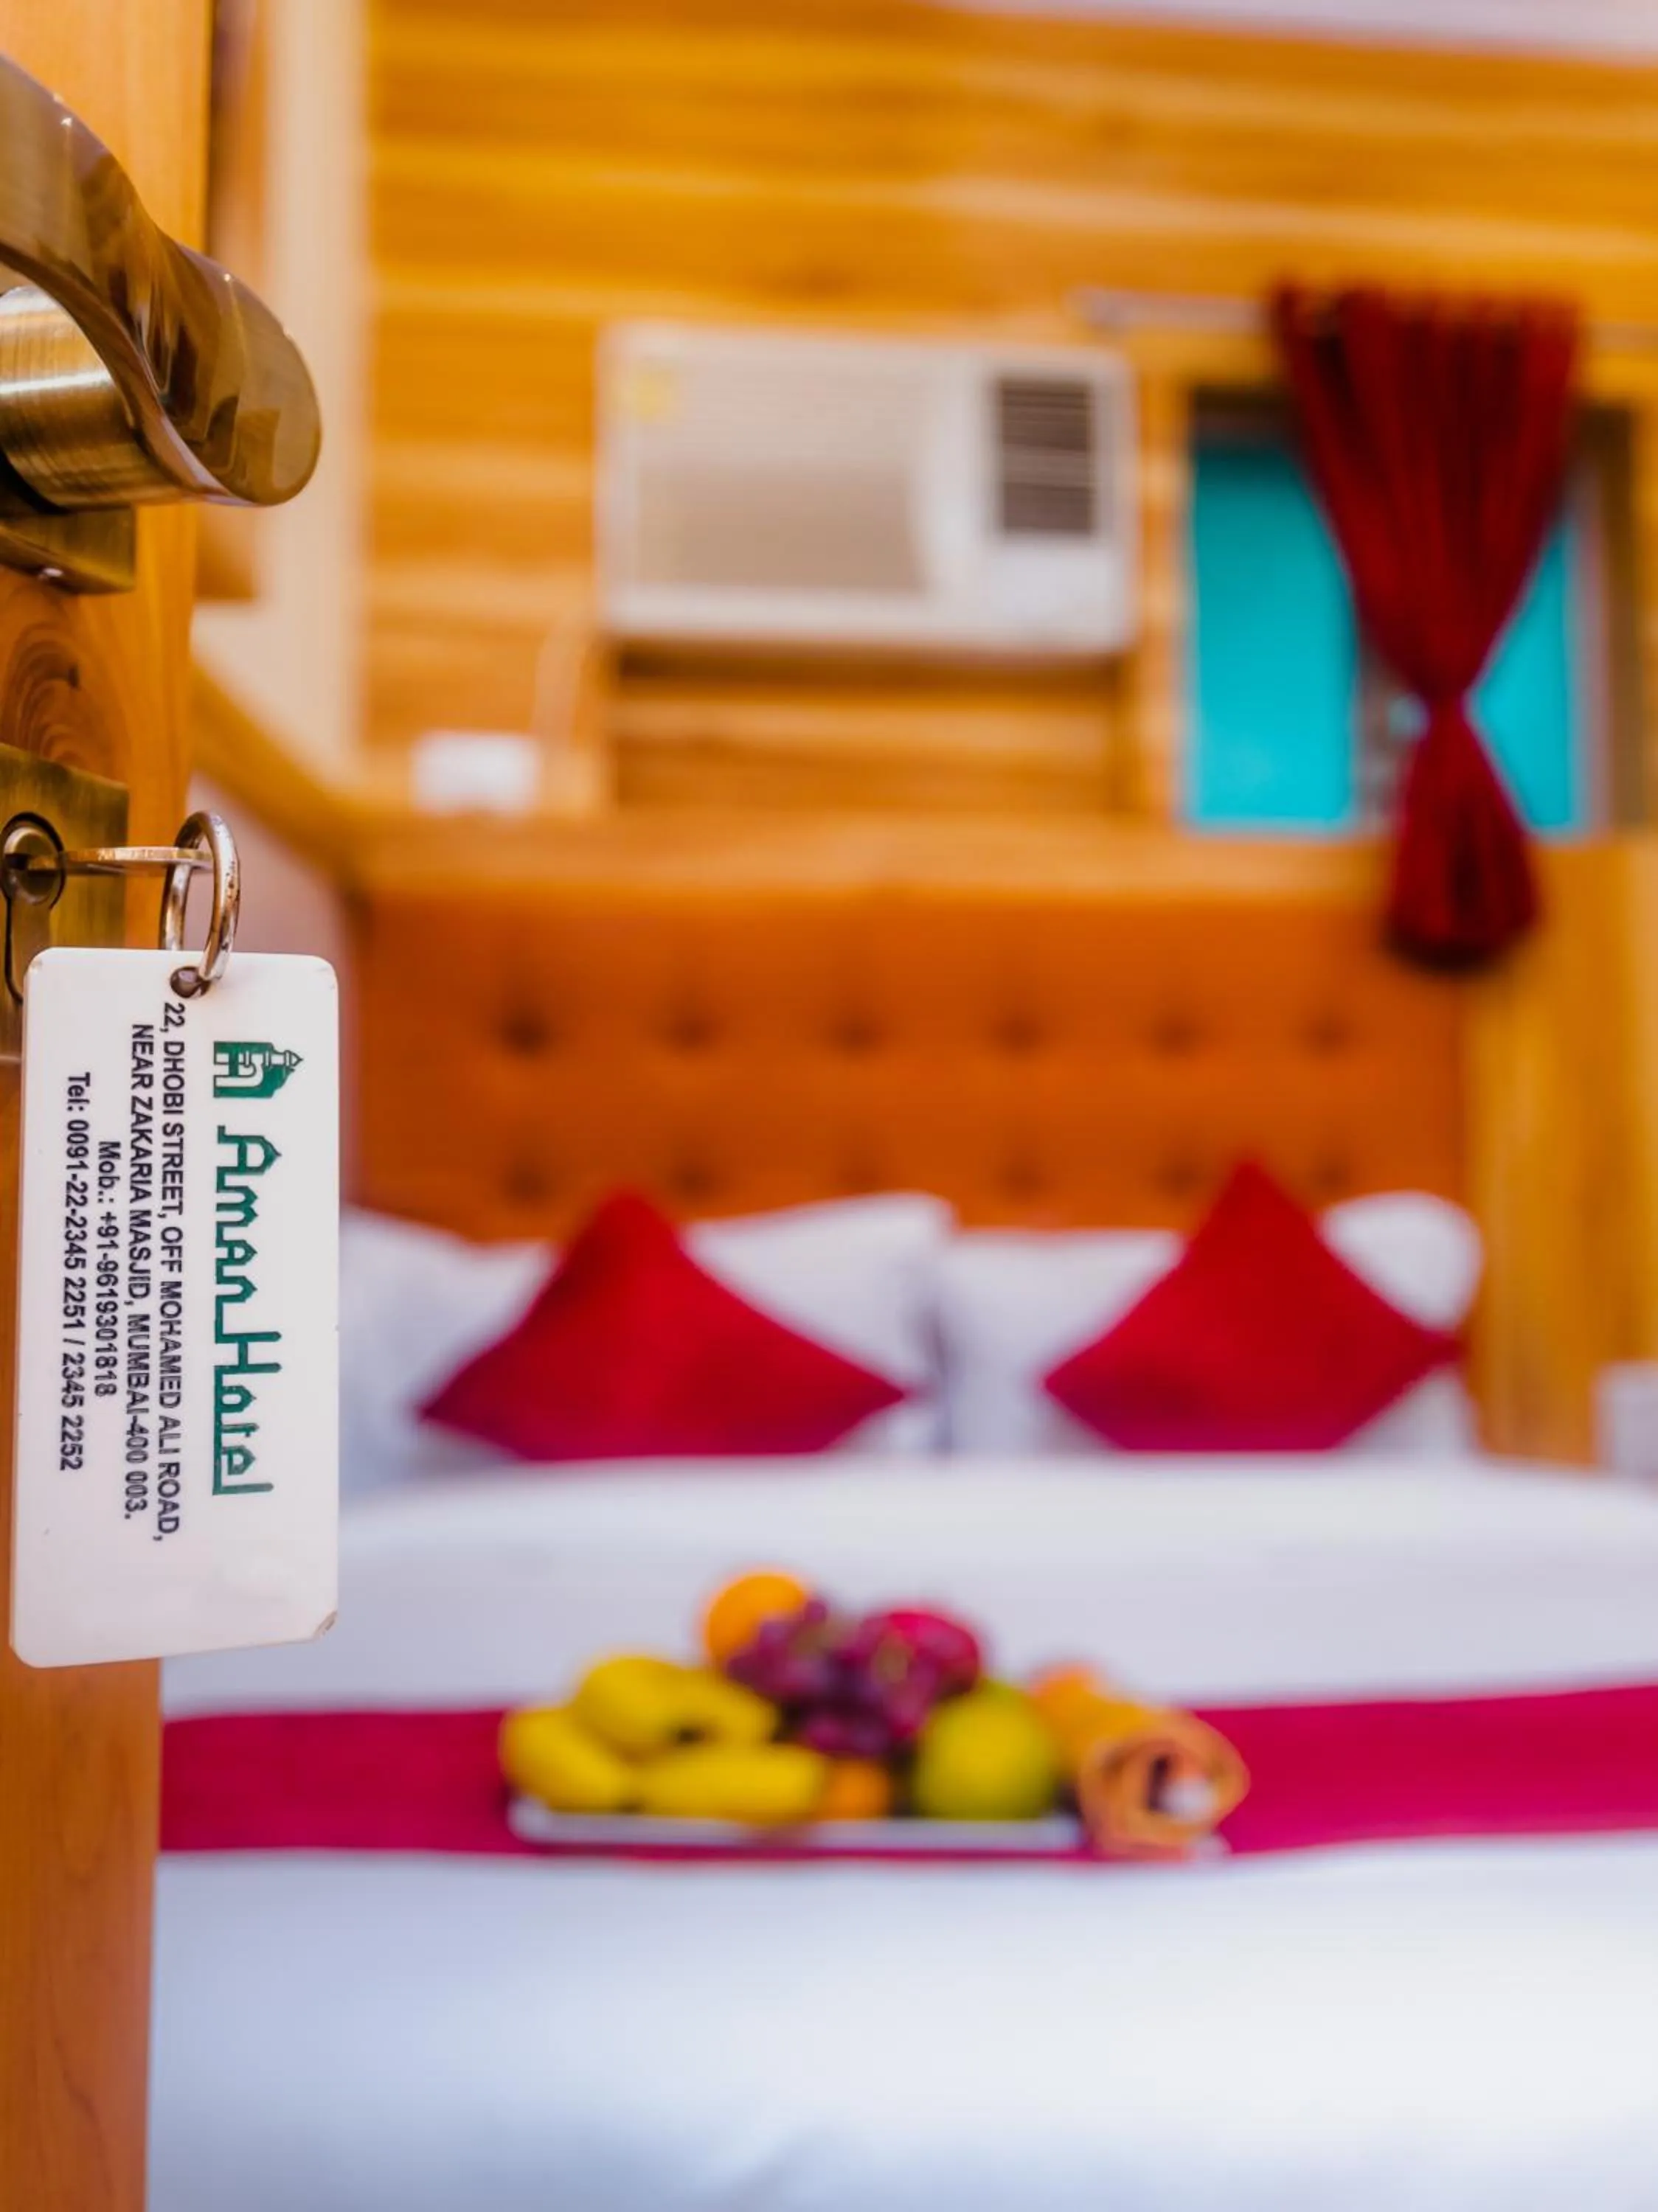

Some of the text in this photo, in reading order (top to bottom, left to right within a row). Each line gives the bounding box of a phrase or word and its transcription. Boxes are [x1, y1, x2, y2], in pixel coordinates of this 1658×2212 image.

[131, 1023, 154, 1091] NEAR
[129, 1095, 154, 1204] ZAKARIA
[59, 1071, 91, 1472] Tel: 0091-22-2345 2251 / 2345 2252
[94, 1141, 122, 1397] Mob.: +91-9619301818
[123, 1208, 153, 1307] MASJID,
[153, 1002, 186, 1542] 22, DHOBI STREET, OFF MOHAMED ALI ROAD,
[124, 1470, 149, 1520] 003.
